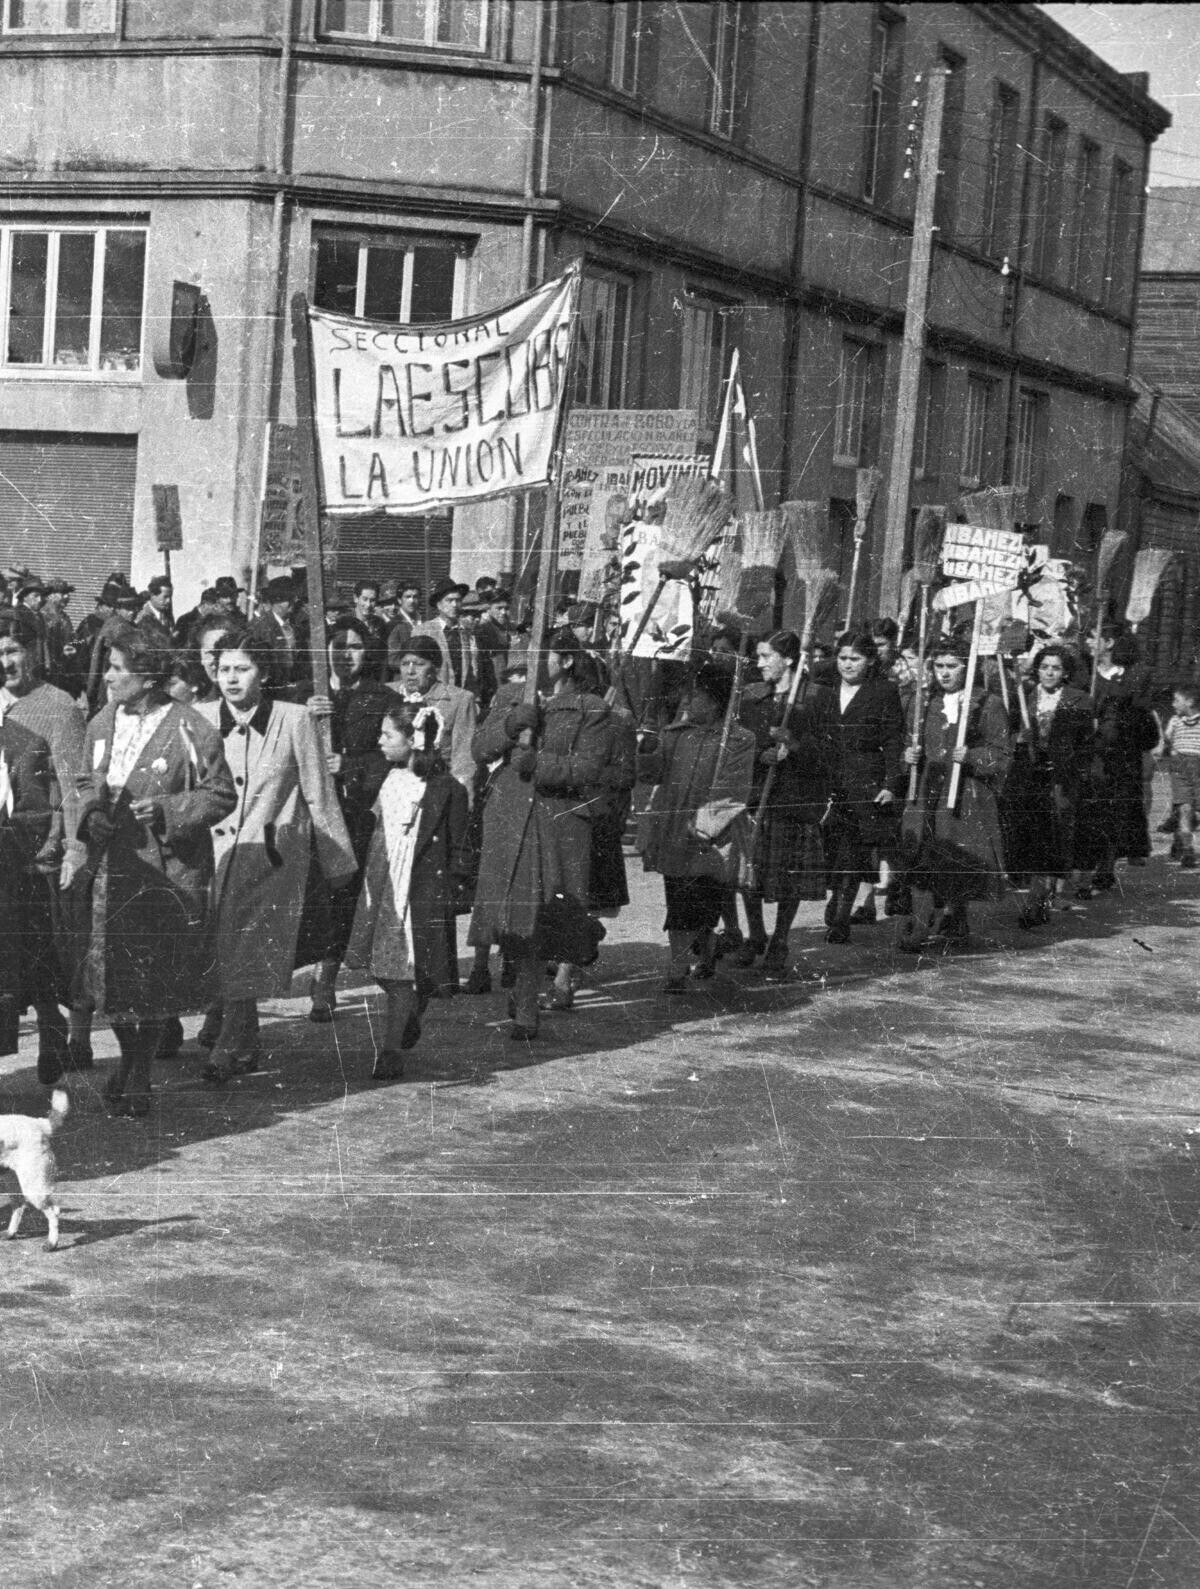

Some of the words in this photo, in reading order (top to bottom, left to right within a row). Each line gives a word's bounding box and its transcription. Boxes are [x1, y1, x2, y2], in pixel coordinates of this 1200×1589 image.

[330, 318, 509, 355] SECCIONAL
[332, 364, 407, 439] LA
[634, 413, 675, 430] ROBO
[339, 453, 389, 499] LA
[413, 433, 523, 492] UNION
